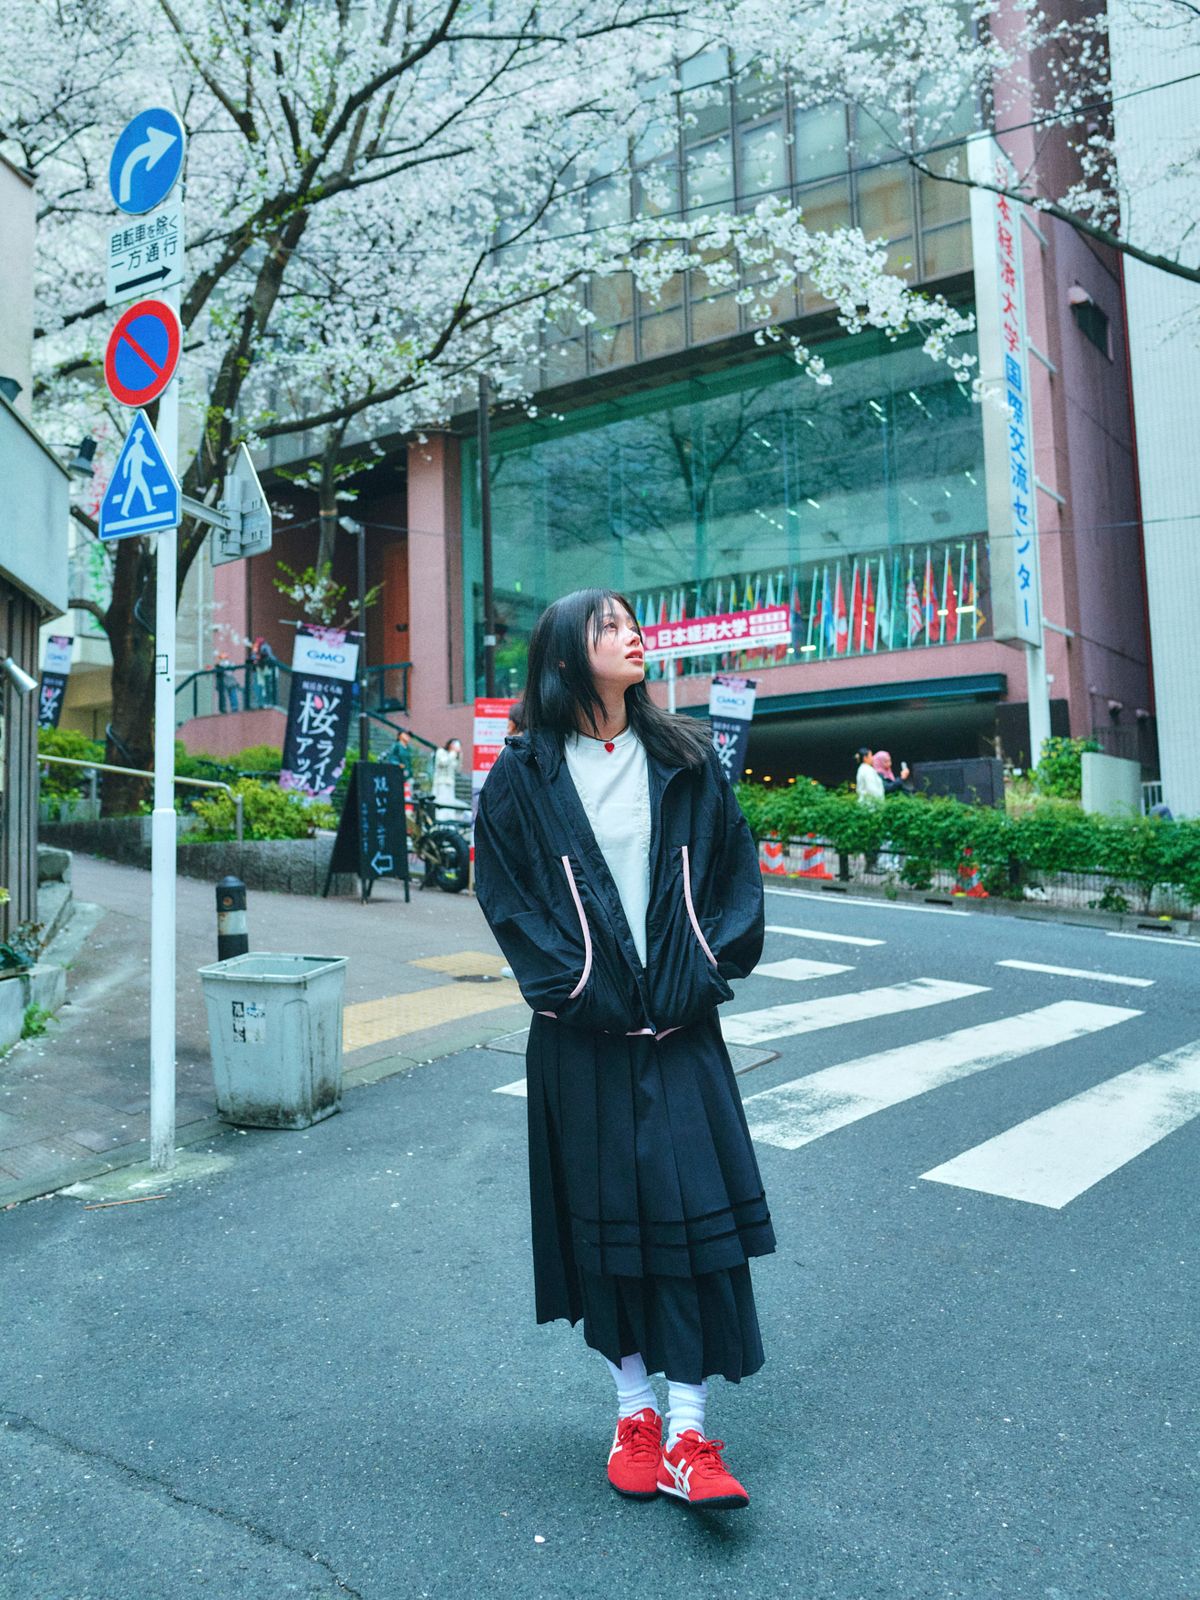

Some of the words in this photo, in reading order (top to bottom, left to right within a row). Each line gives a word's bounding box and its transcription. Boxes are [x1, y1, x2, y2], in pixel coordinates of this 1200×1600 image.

[111, 235, 178, 270] 一方通行
[112, 214, 177, 253] 自転車を除く
[657, 617, 748, 648] 日本経済大学
[307, 649, 345, 664] GMO
[297, 691, 341, 737] 桜
[292, 737, 315, 788] アップ
[314, 740, 335, 792] ライト
